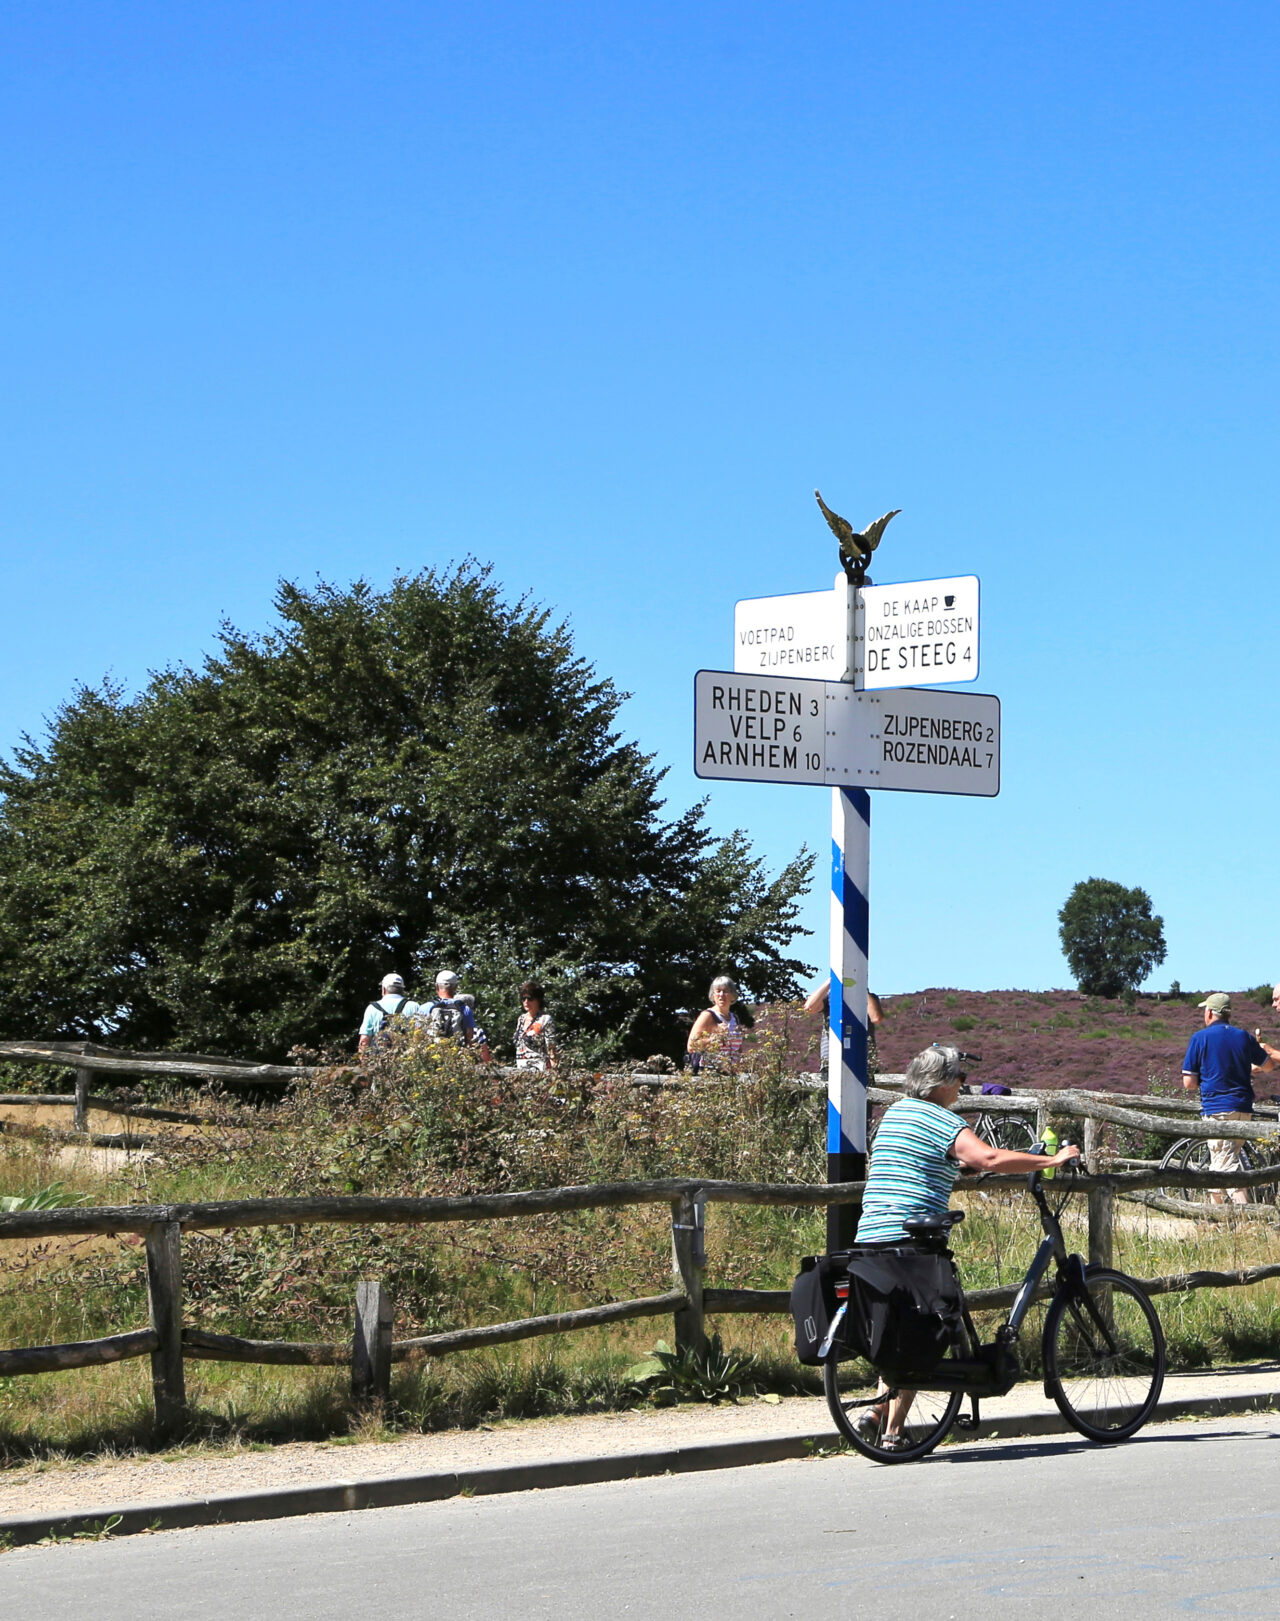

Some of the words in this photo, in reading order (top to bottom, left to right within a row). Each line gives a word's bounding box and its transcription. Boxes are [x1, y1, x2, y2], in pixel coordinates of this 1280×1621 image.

[884, 601, 898, 616] DE
[904, 597, 938, 615] KAAP
[740, 626, 795, 645] VOETPAD
[868, 621, 924, 642] ONZALIGE
[928, 617, 972, 636] BOSSEN
[868, 648, 890, 672] DE
[898, 642, 956, 669] STEEG
[963, 646, 972, 662] 4
[712, 686, 802, 716] RHEDEN
[810, 700, 819, 716] 3
[730, 715, 786, 740] VELP
[794, 726, 802, 742] 6
[884, 714, 982, 742] ZIJPENBERG
[986, 728, 994, 743] 2
[702, 740, 797, 769] ARNHEM
[805, 753, 820, 770] 10
[884, 741, 982, 768] ROZENDAAL
[986, 754, 994, 768] 7
